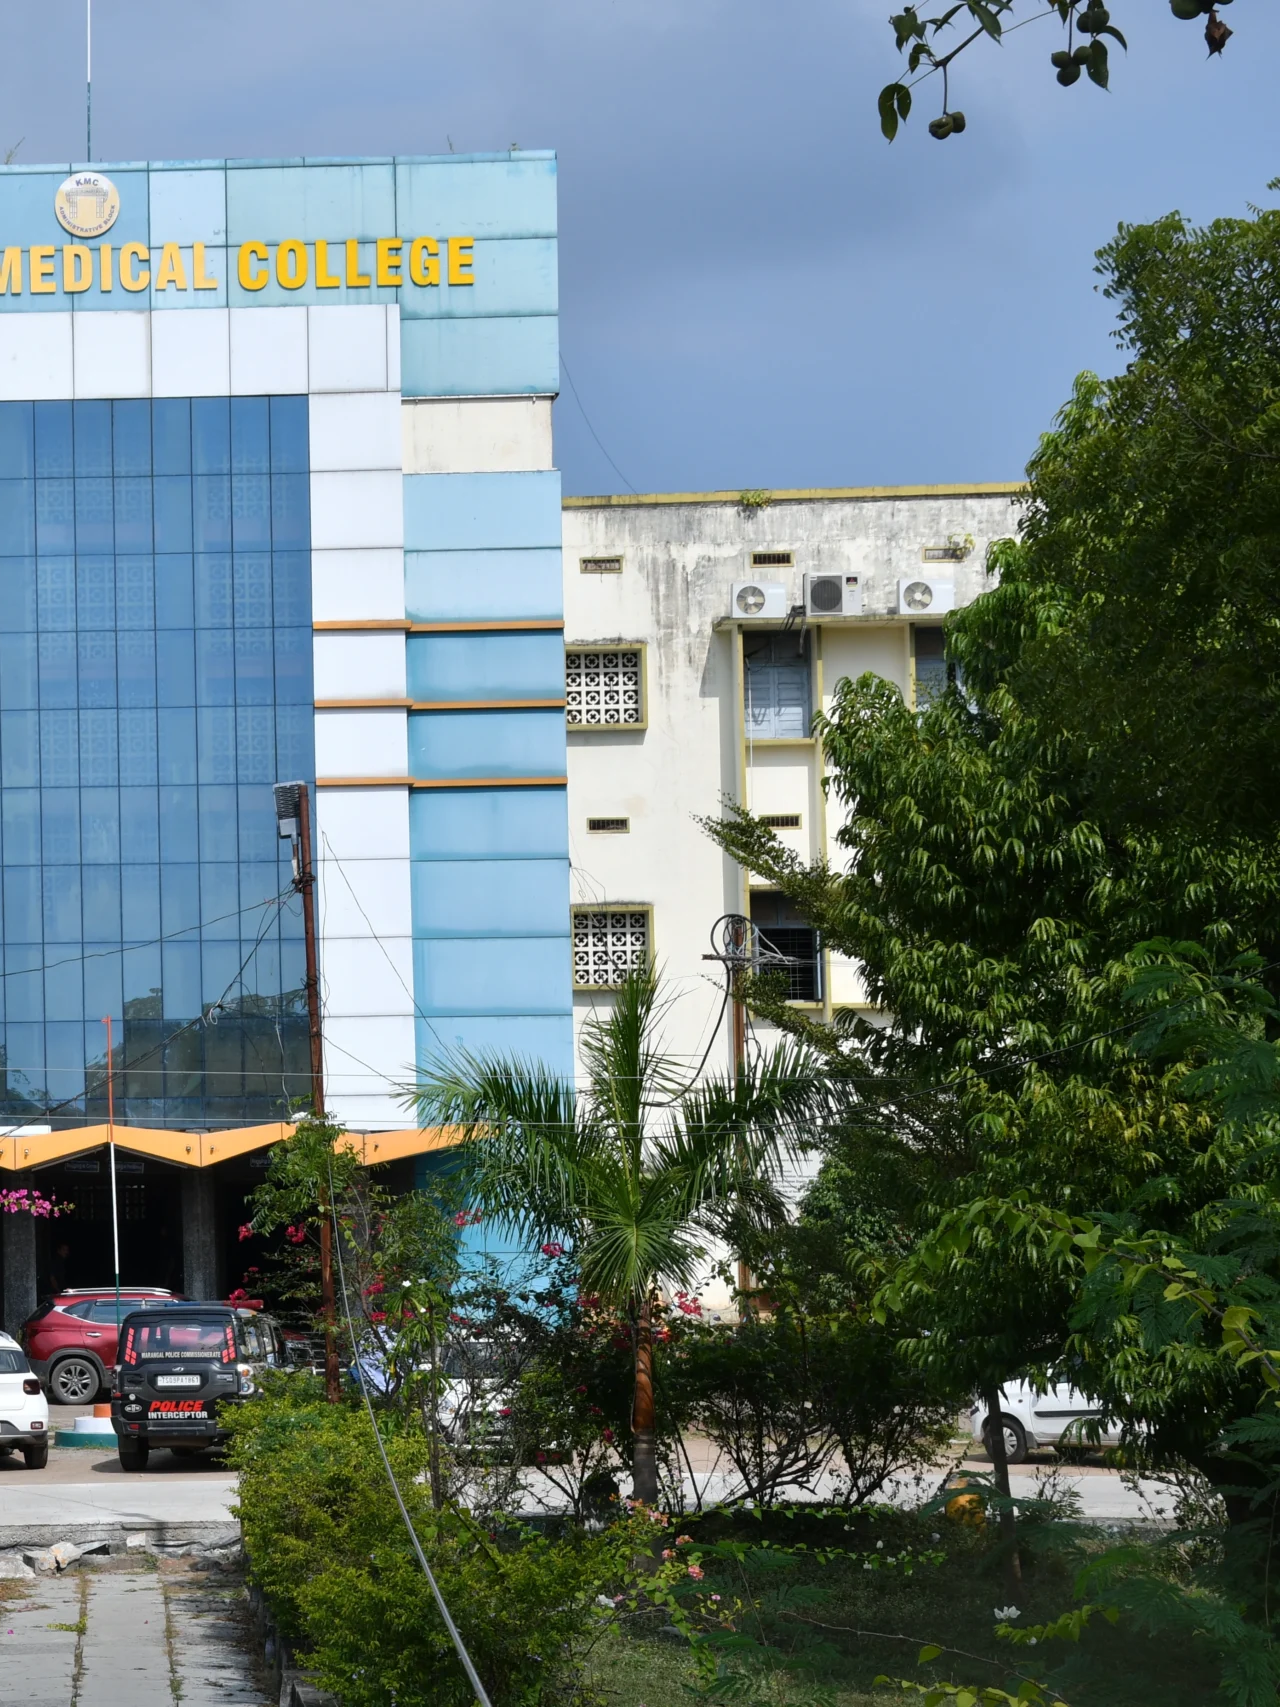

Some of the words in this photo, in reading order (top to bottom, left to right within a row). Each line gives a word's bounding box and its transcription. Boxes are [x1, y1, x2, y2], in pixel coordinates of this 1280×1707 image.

[75, 177, 99, 187] KMC
[59, 206, 103, 233] ADMINISTRATIVE
[103, 204, 116, 226] BLOCK
[237, 235, 476, 290] COLLEGE
[149, 1400, 204, 1412] POLICE
[148, 1411, 208, 1419] INTERCEPTOR
